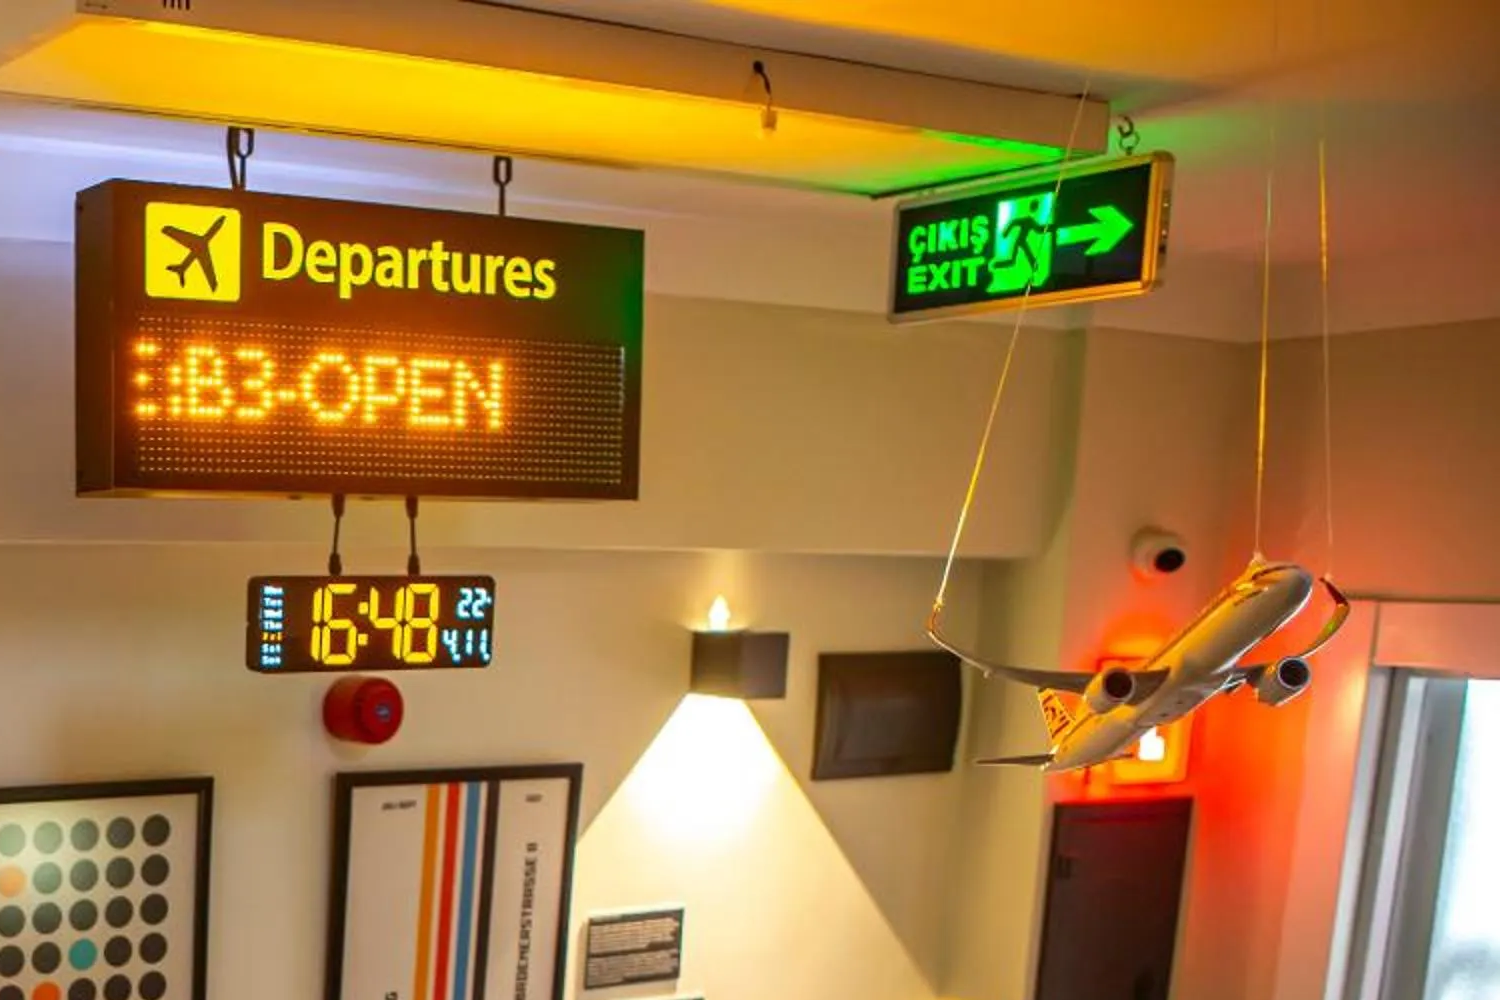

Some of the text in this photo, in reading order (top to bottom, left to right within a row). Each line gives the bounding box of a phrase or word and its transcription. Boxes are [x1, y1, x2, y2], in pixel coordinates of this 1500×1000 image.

[261, 221, 557, 300] Departures
[909, 215, 989, 263] ÇIKIŞ
[907, 256, 986, 295] EXIT
[311, 583, 439, 665] 16:48
